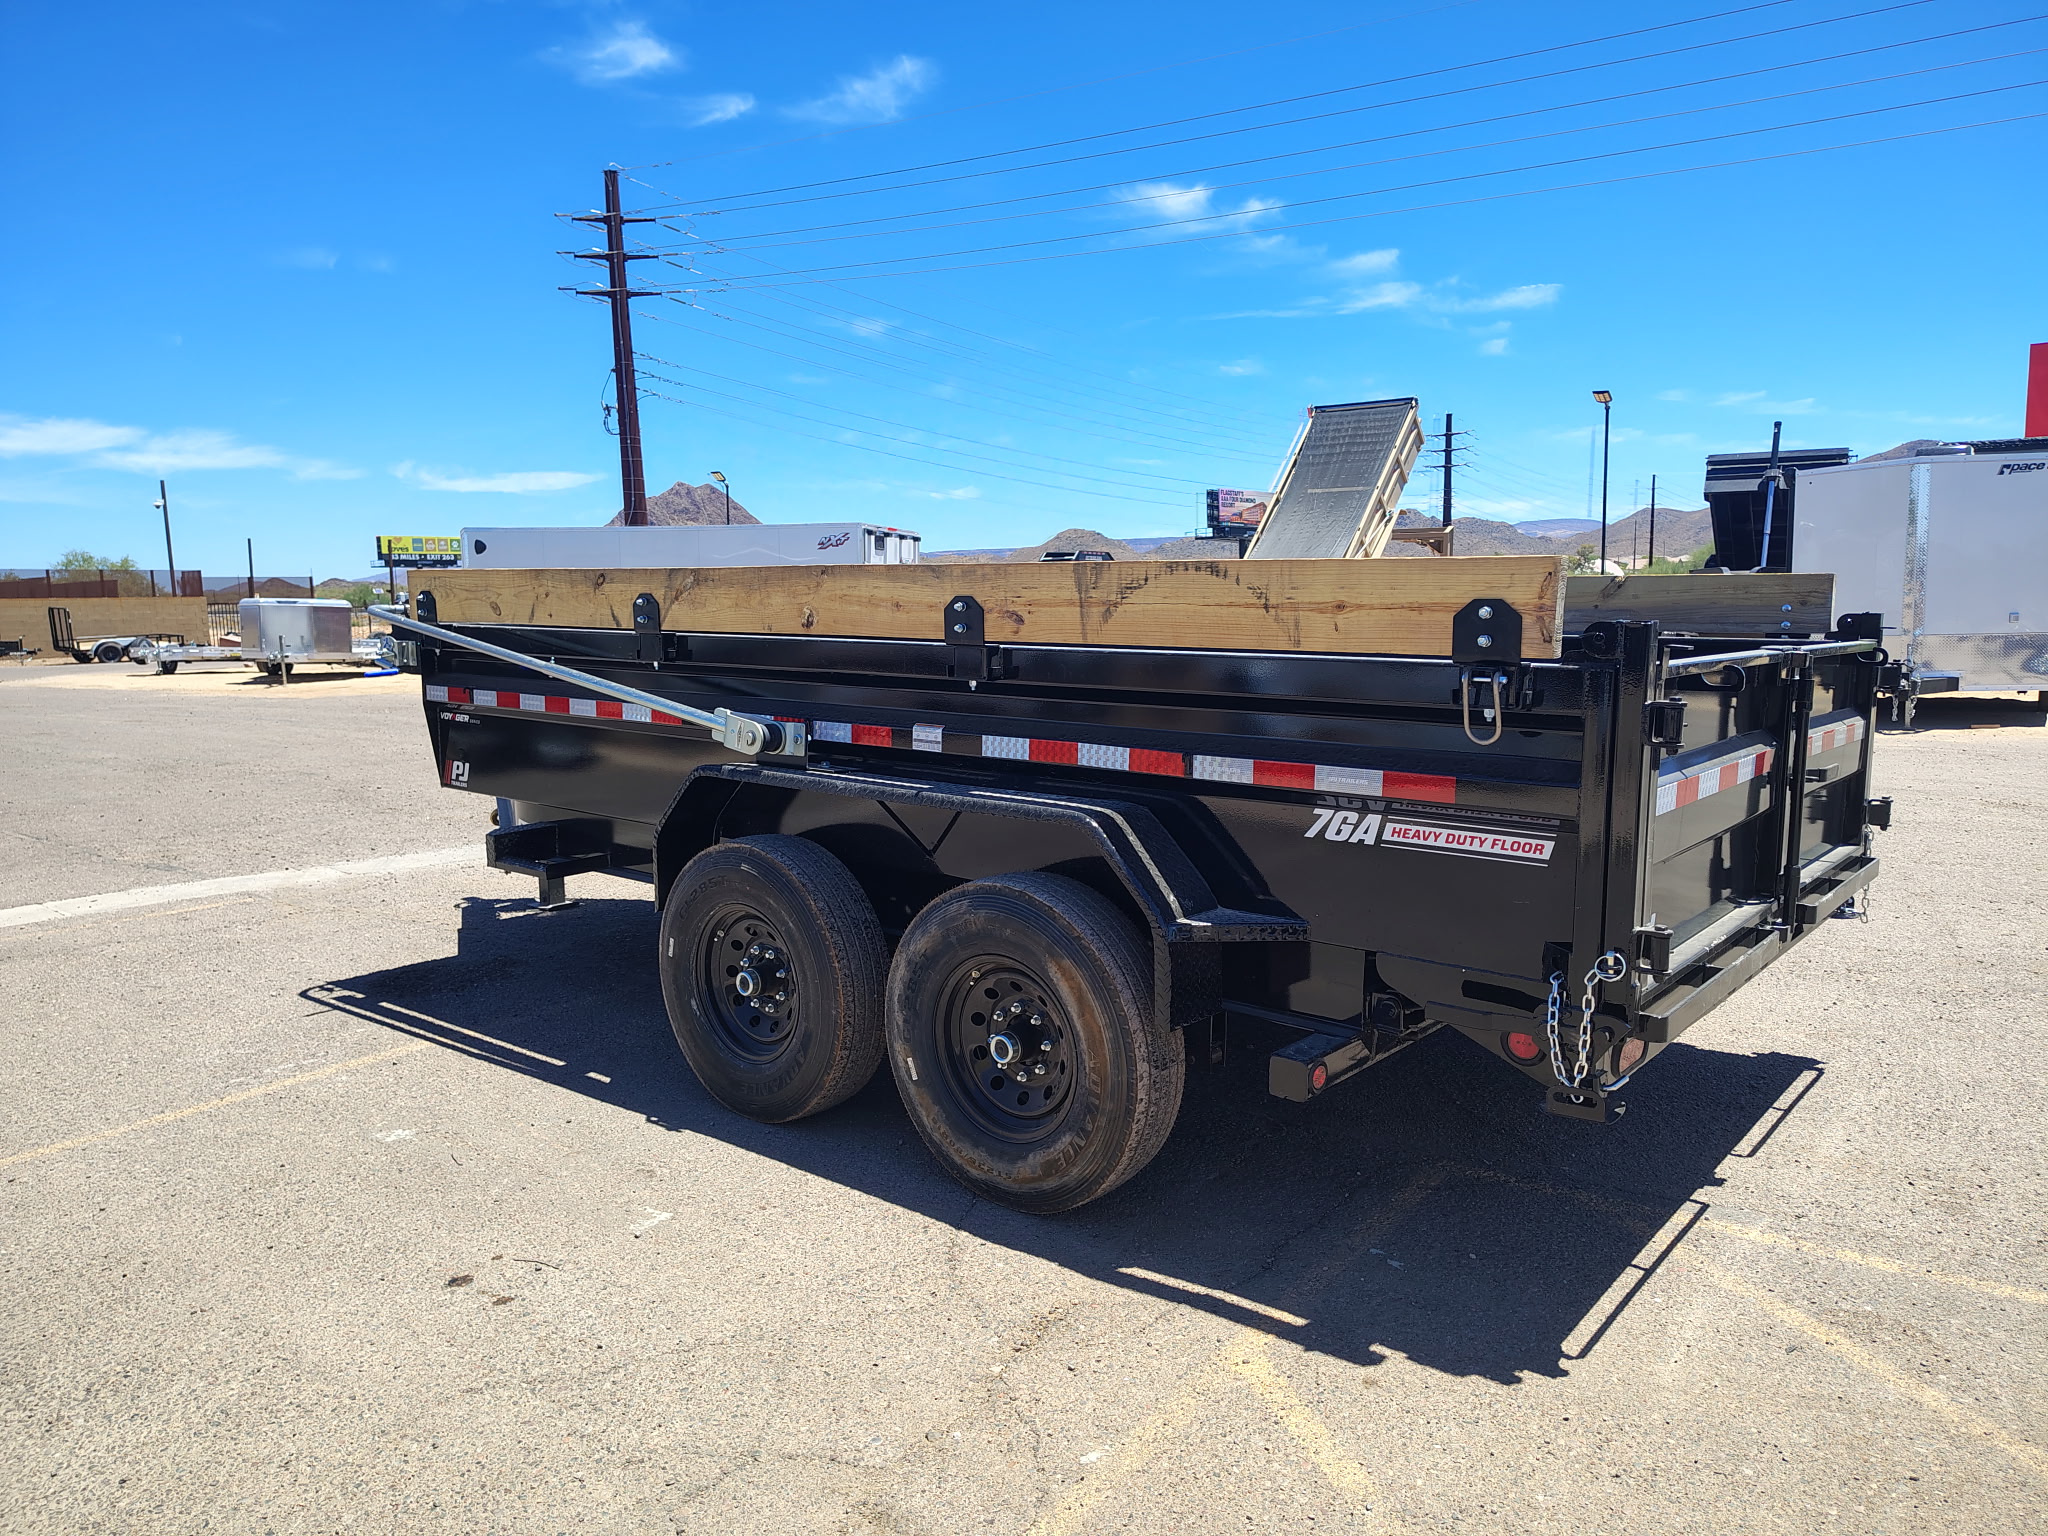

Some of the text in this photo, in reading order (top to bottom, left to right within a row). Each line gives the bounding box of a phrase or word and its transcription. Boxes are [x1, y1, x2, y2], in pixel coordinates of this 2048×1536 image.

[451, 760, 470, 782] PJ
[1304, 808, 1383, 846] 7GA
[1390, 826, 1546, 856] HEAVY DUTY FLOOR
